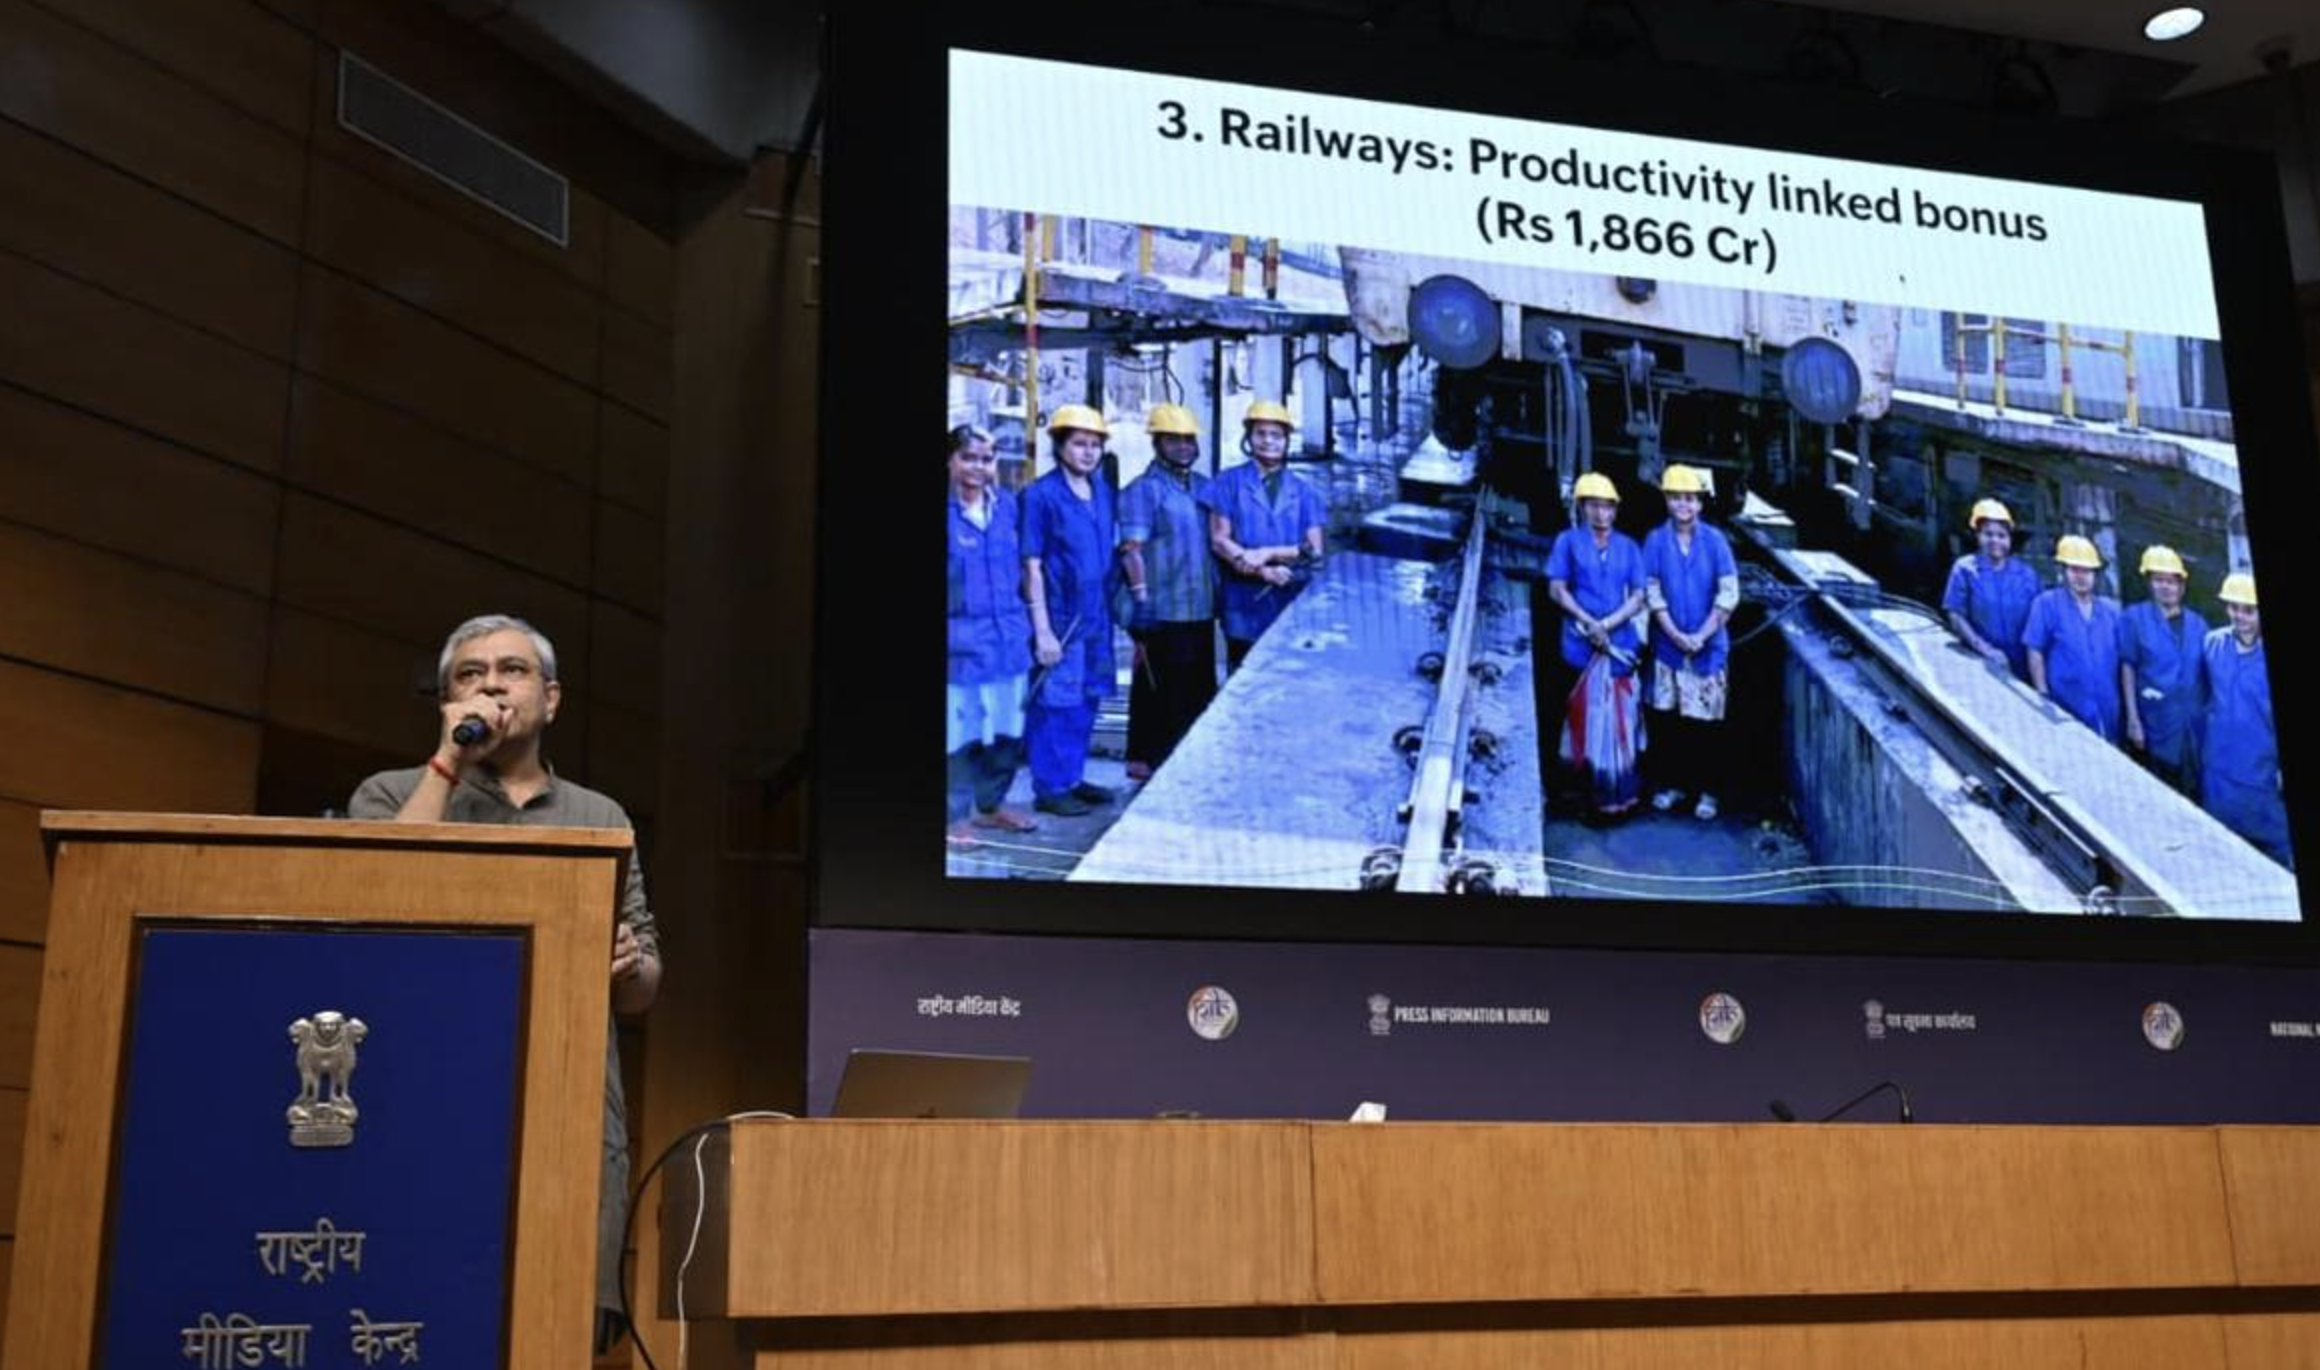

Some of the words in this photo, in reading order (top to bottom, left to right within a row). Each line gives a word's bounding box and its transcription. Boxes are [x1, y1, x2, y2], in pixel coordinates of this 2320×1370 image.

[1158, 101, 1203, 142] 3.
[1221, 107, 1453, 174] Railways:
[1470, 138, 1753, 215] Productivity
[1768, 173, 1901, 225] linked
[1915, 190, 2047, 241] bonus
[1477, 197, 1554, 243] (Rs
[1566, 211, 1694, 258] 1,866
[1708, 226, 1776, 273] Cr)
[1395, 1006, 1429, 1023] PRESS
[1431, 1007, 1504, 1023] INFORMATION
[1507, 1009, 1549, 1024] BUREAU
[256, 1217, 366, 1283] राष्ट्रीय
[181, 1312, 312, 1369] मीडिया
[350, 1309, 423, 1364] केन्द्र
